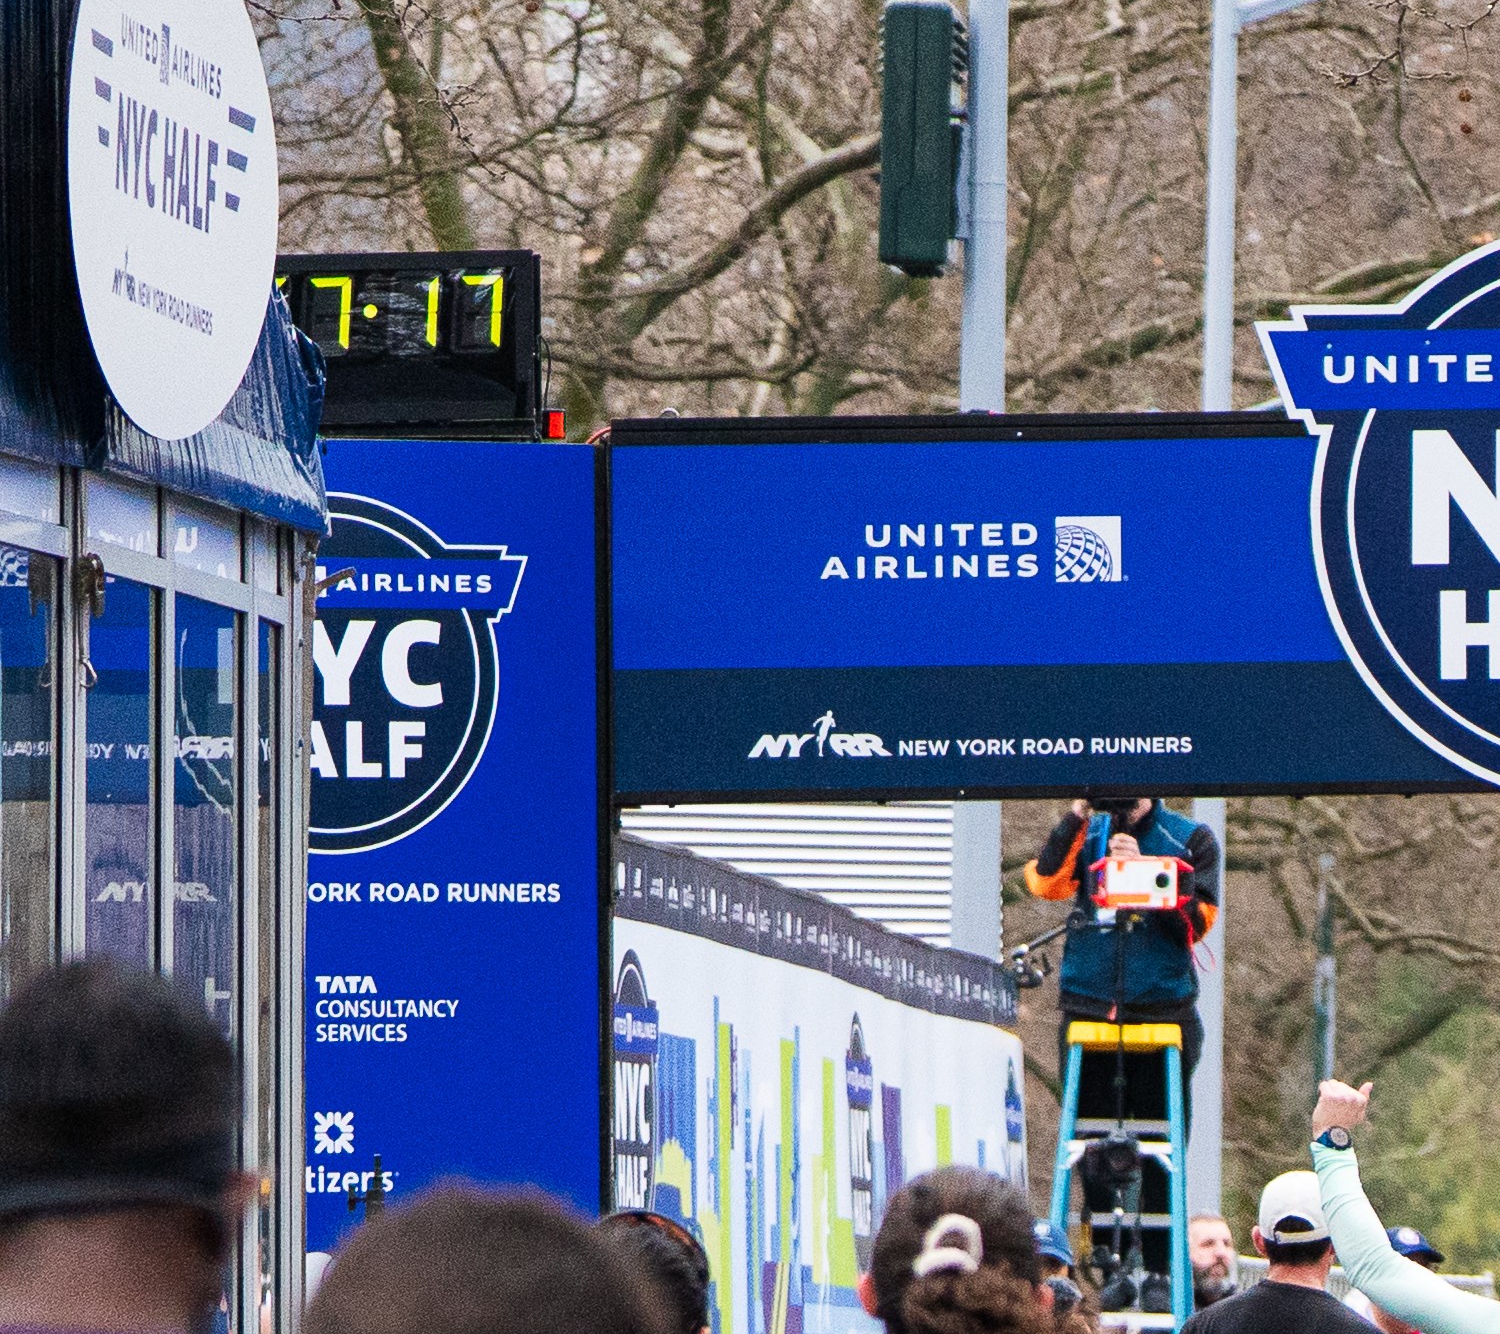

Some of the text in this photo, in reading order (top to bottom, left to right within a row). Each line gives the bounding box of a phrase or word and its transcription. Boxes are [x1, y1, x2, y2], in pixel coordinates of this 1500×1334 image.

[121, 14, 222, 99] UNITED AIRLINES
[115, 92, 219, 234] NYC HALF
[866, 523, 1037, 547] UNITED
[821, 554, 1038, 579] AIRLINES
[337, 569, 491, 593] AIRLINES
[312, 620, 443, 707] YC
[309, 718, 425, 778] ALF
[747, 720, 1192, 758] NYRR NEW YORK ROAD RUNNERS
[306, 882, 560, 903] ORK ROAD RUNNERS
[315, 976, 377, 993] TATA
[316, 1000, 458, 1017] CONSULTANCY
[316, 1024, 407, 1042] SERVICES
[306, 1165, 394, 1194] tizens
